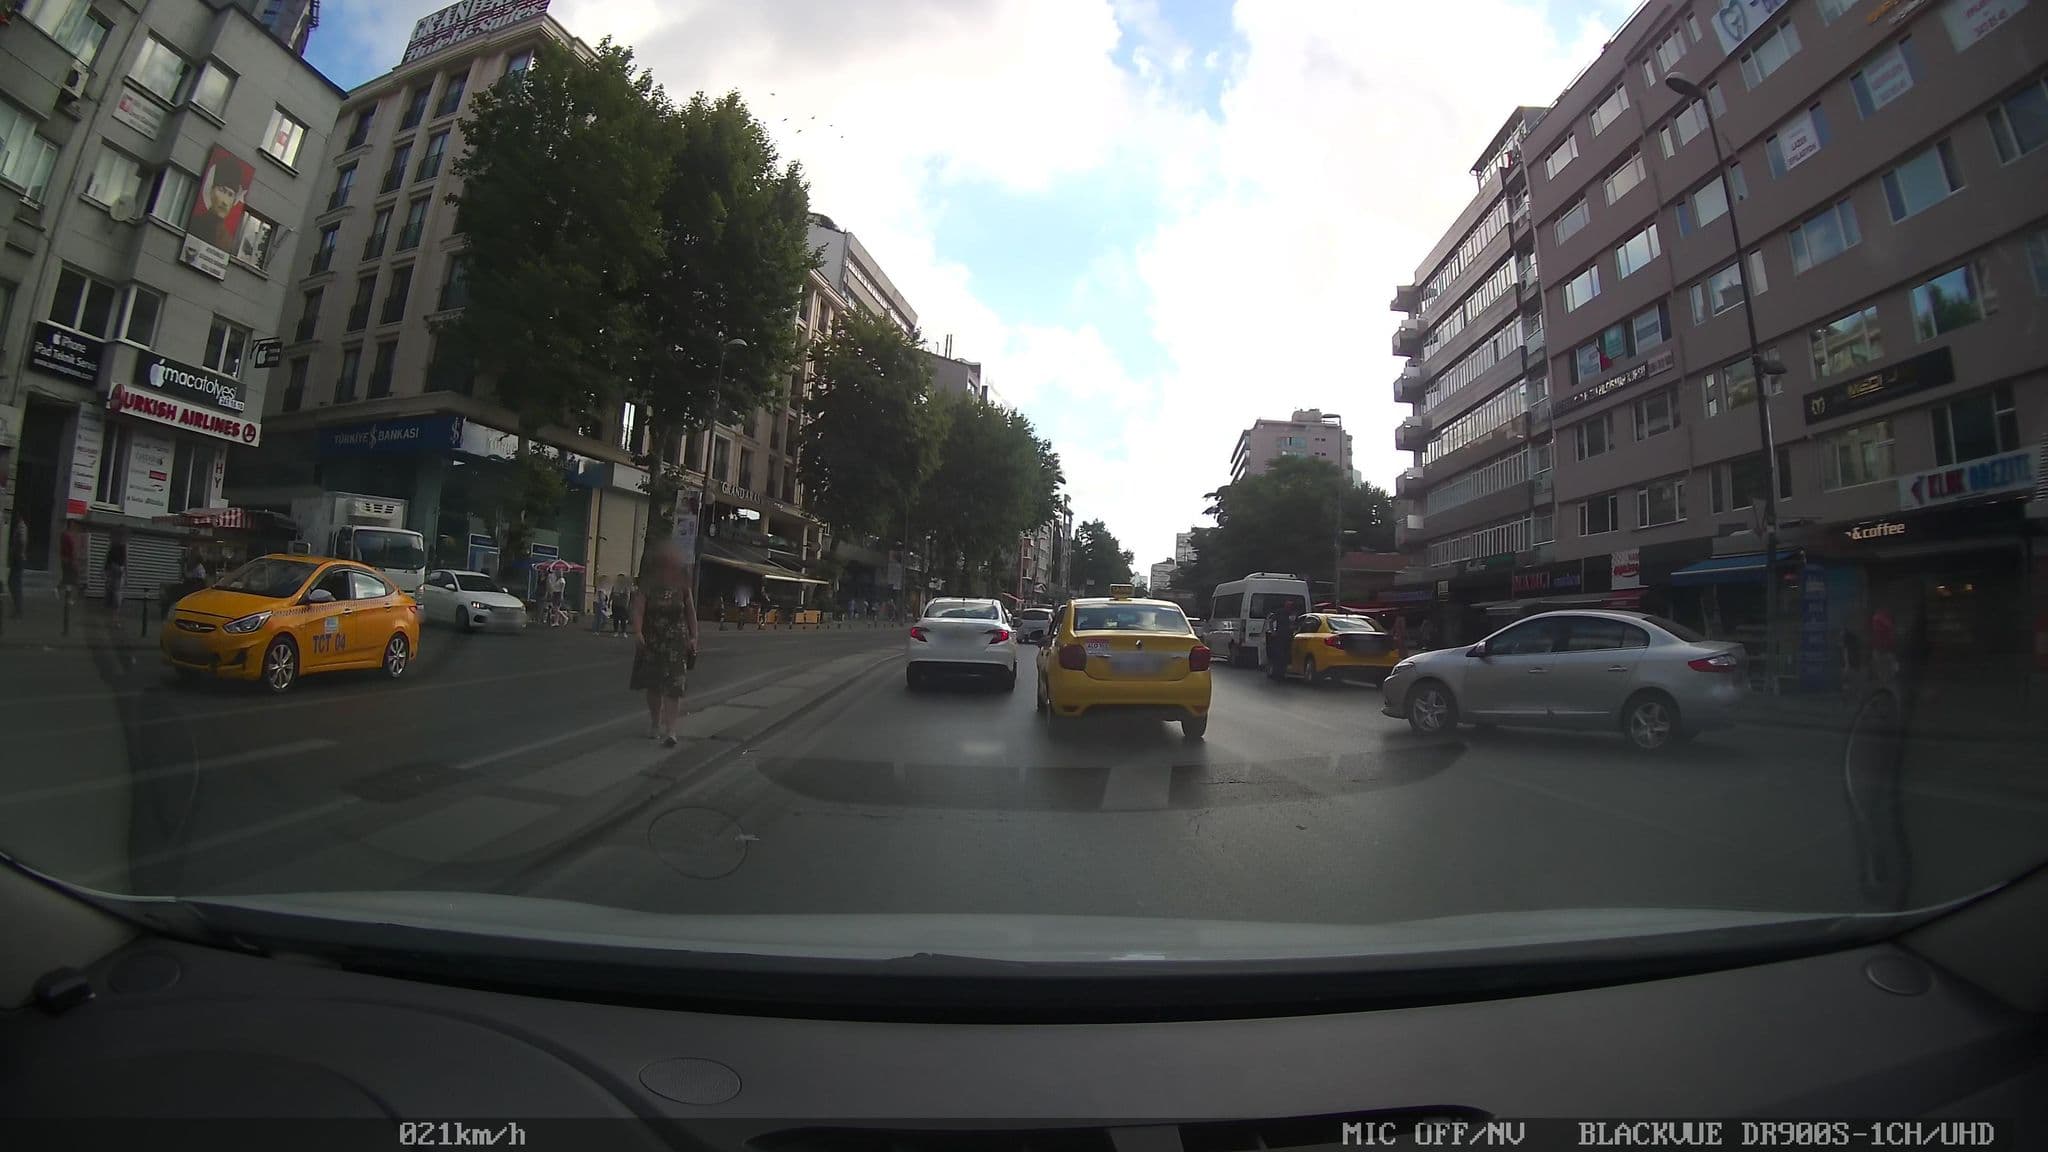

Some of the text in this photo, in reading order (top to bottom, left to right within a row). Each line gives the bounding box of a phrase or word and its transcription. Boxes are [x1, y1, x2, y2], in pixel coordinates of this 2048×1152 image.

[179, 408, 241, 437] AIRLINES
[378, 426, 420, 441] BANKASI
[312, 633, 332, 654] TCT
